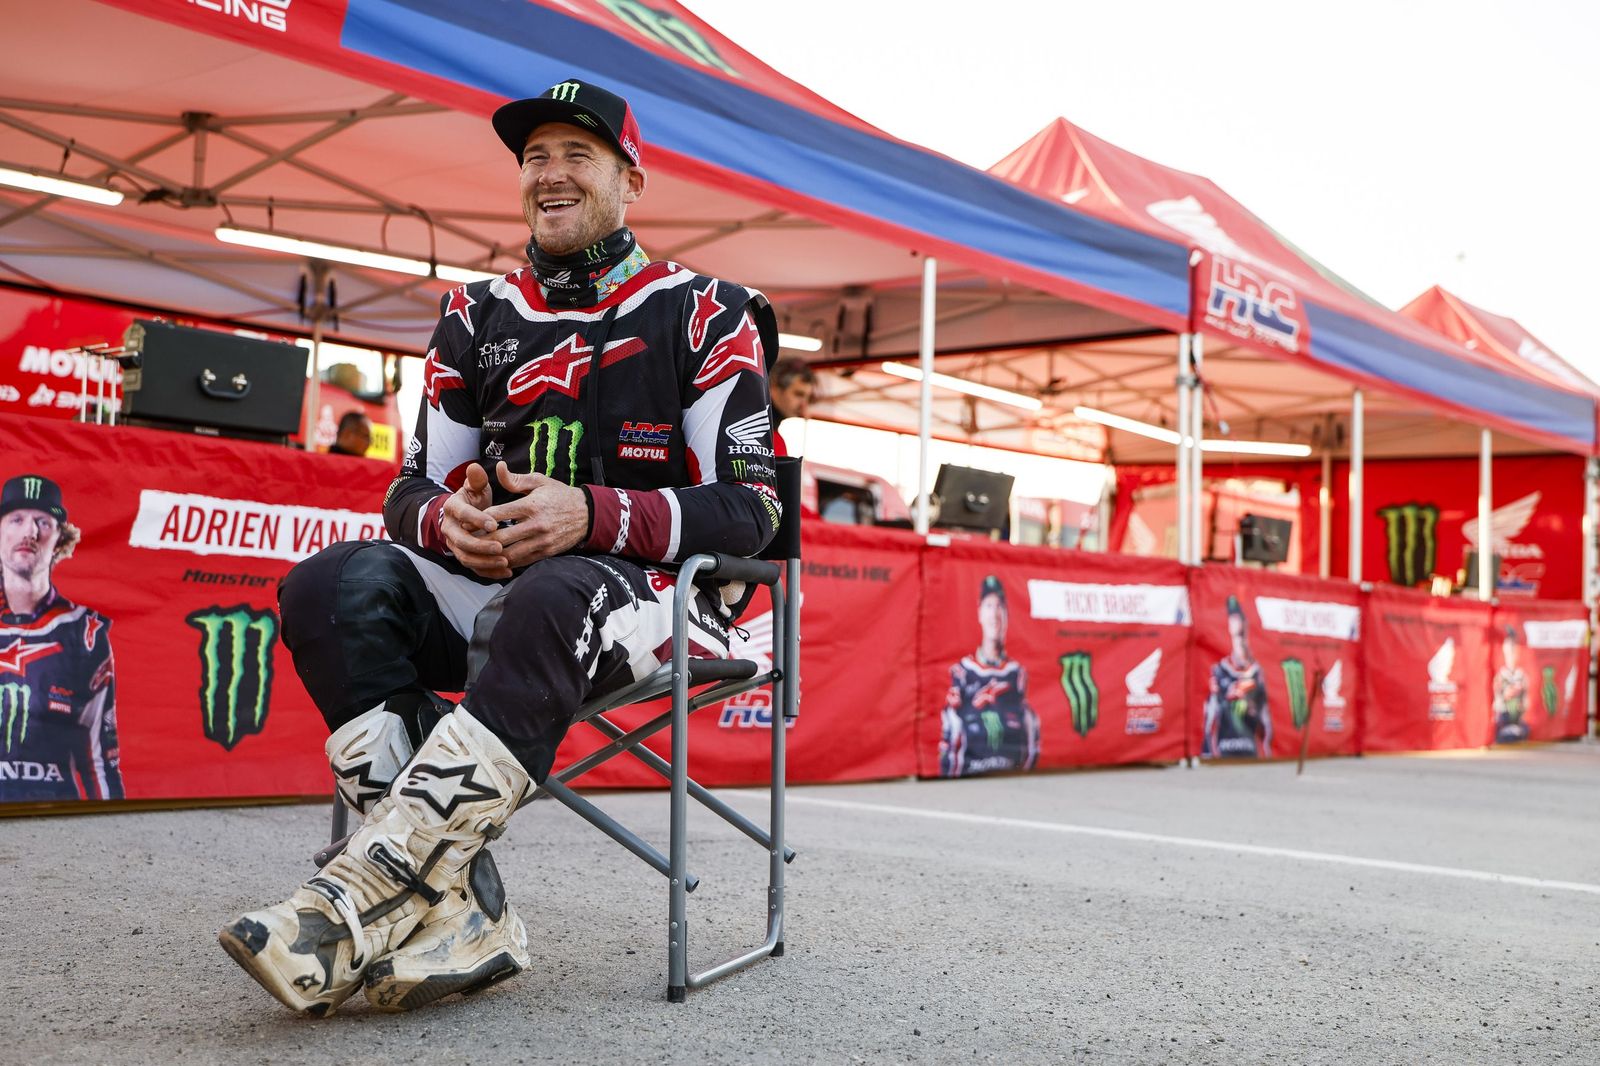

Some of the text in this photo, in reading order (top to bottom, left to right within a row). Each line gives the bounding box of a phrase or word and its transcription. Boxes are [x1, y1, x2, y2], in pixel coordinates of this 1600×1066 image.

[543, 278, 581, 289] HONDA
[619, 421, 673, 441] HRC
[620, 446, 666, 460] MOTUL
[727, 445, 775, 459] HONDA
[160, 504, 281, 551] ADRIEN
[293, 516, 348, 554] VAN
[182, 568, 275, 587] Monster
[0, 760, 65, 782] NDA
